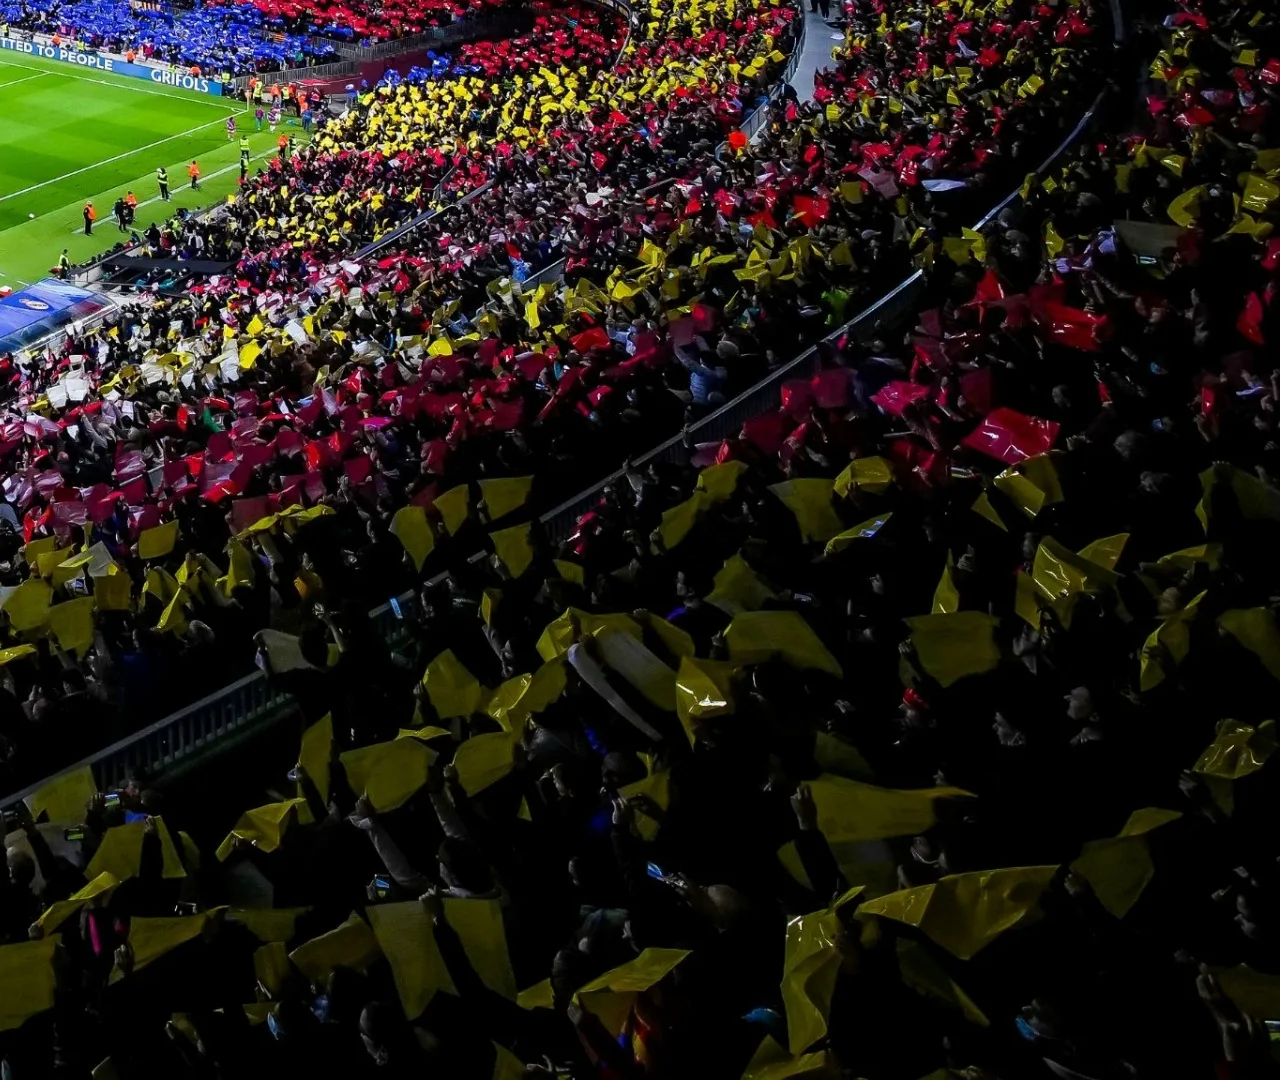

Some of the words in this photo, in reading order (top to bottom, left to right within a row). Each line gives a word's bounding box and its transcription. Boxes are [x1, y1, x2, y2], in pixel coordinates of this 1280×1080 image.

[37, 45, 55, 58] TO
[60, 51, 113, 71] PEOPLE
[151, 69, 209, 93] GRIFOLS
